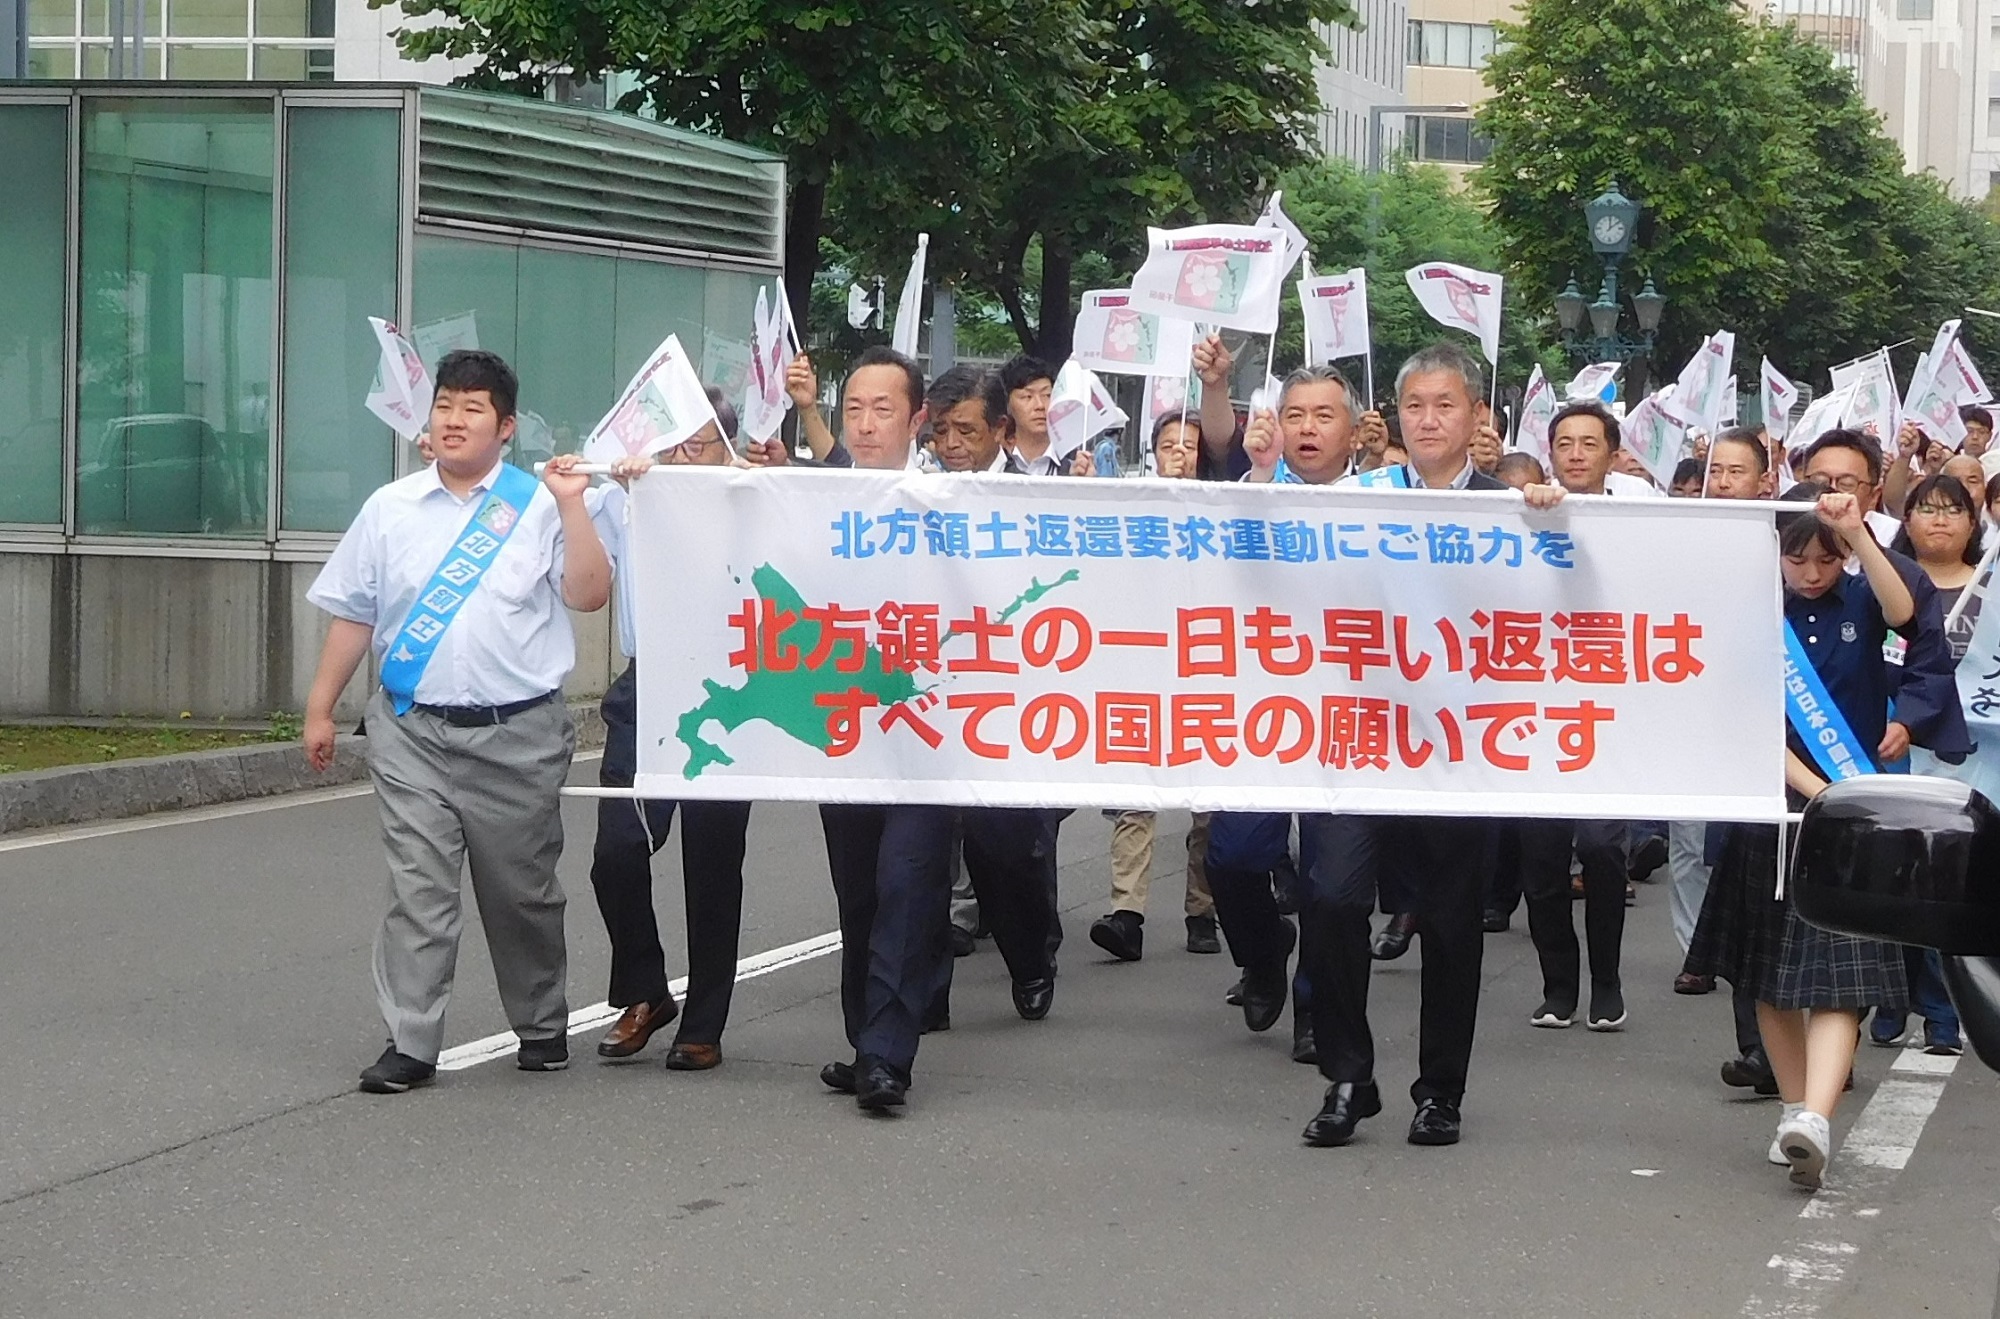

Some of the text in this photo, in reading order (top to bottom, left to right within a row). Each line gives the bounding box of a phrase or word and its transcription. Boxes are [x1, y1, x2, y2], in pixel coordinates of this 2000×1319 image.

[831, 507, 1576, 569] 北方領土返還要求運動にご協力を
[407, 533, 496, 640] 北方領土
[728, 598, 1705, 684] 北方領土の一日も早い返還は
[815, 686, 1616, 773] すべての国民の願いです
